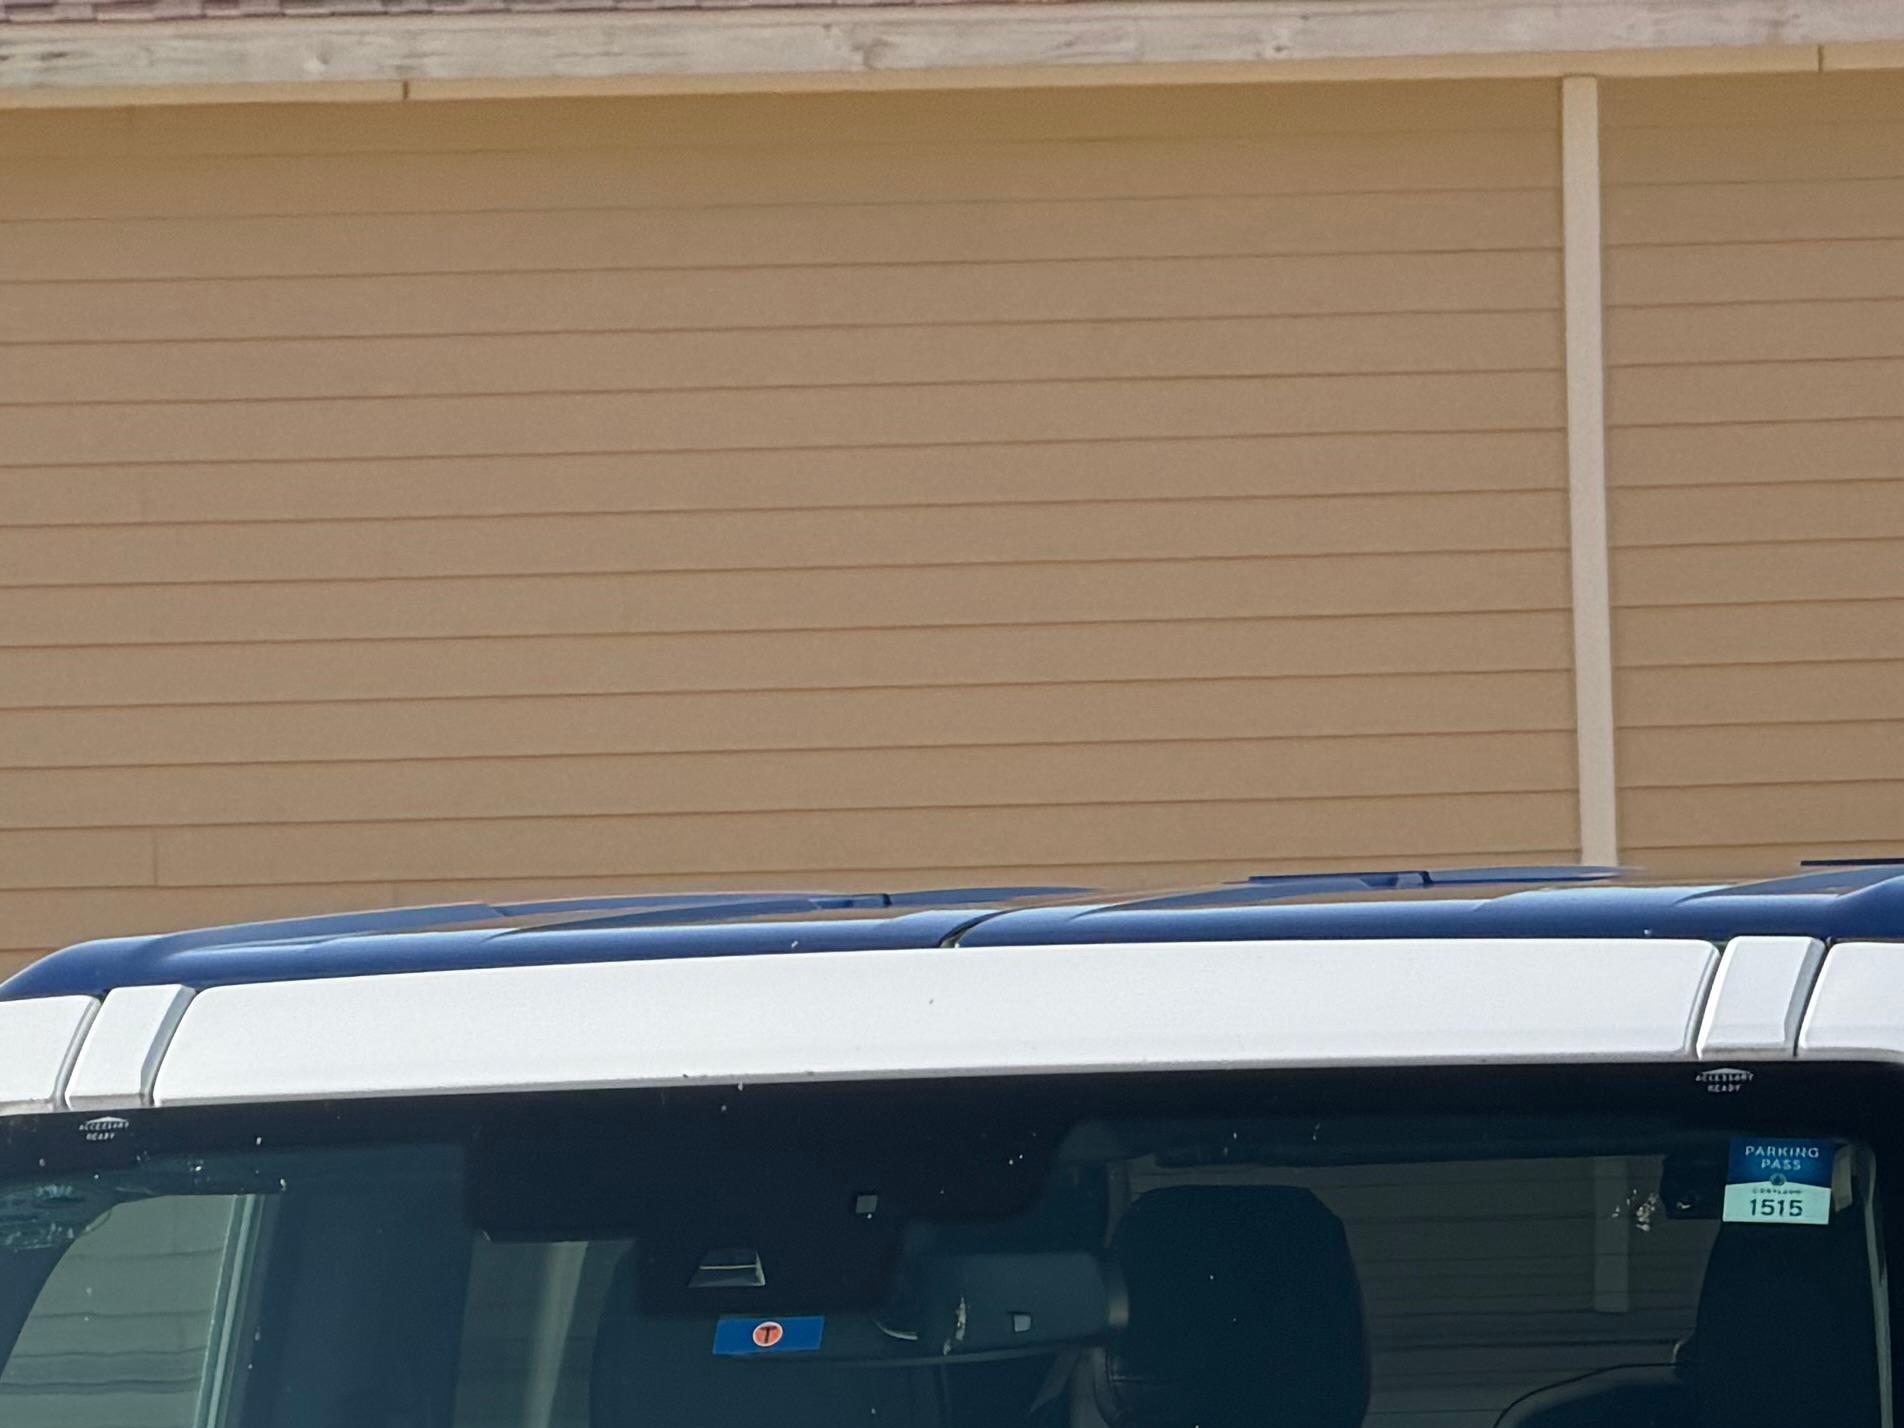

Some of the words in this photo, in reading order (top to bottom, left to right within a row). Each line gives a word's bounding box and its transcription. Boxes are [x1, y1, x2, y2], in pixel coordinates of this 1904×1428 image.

[1707, 1084, 1741, 1093] READY
[1744, 1145, 1820, 1158] PARKING
[1761, 1159, 1802, 1170] PASS
[1750, 1199, 1803, 1217] 1515
